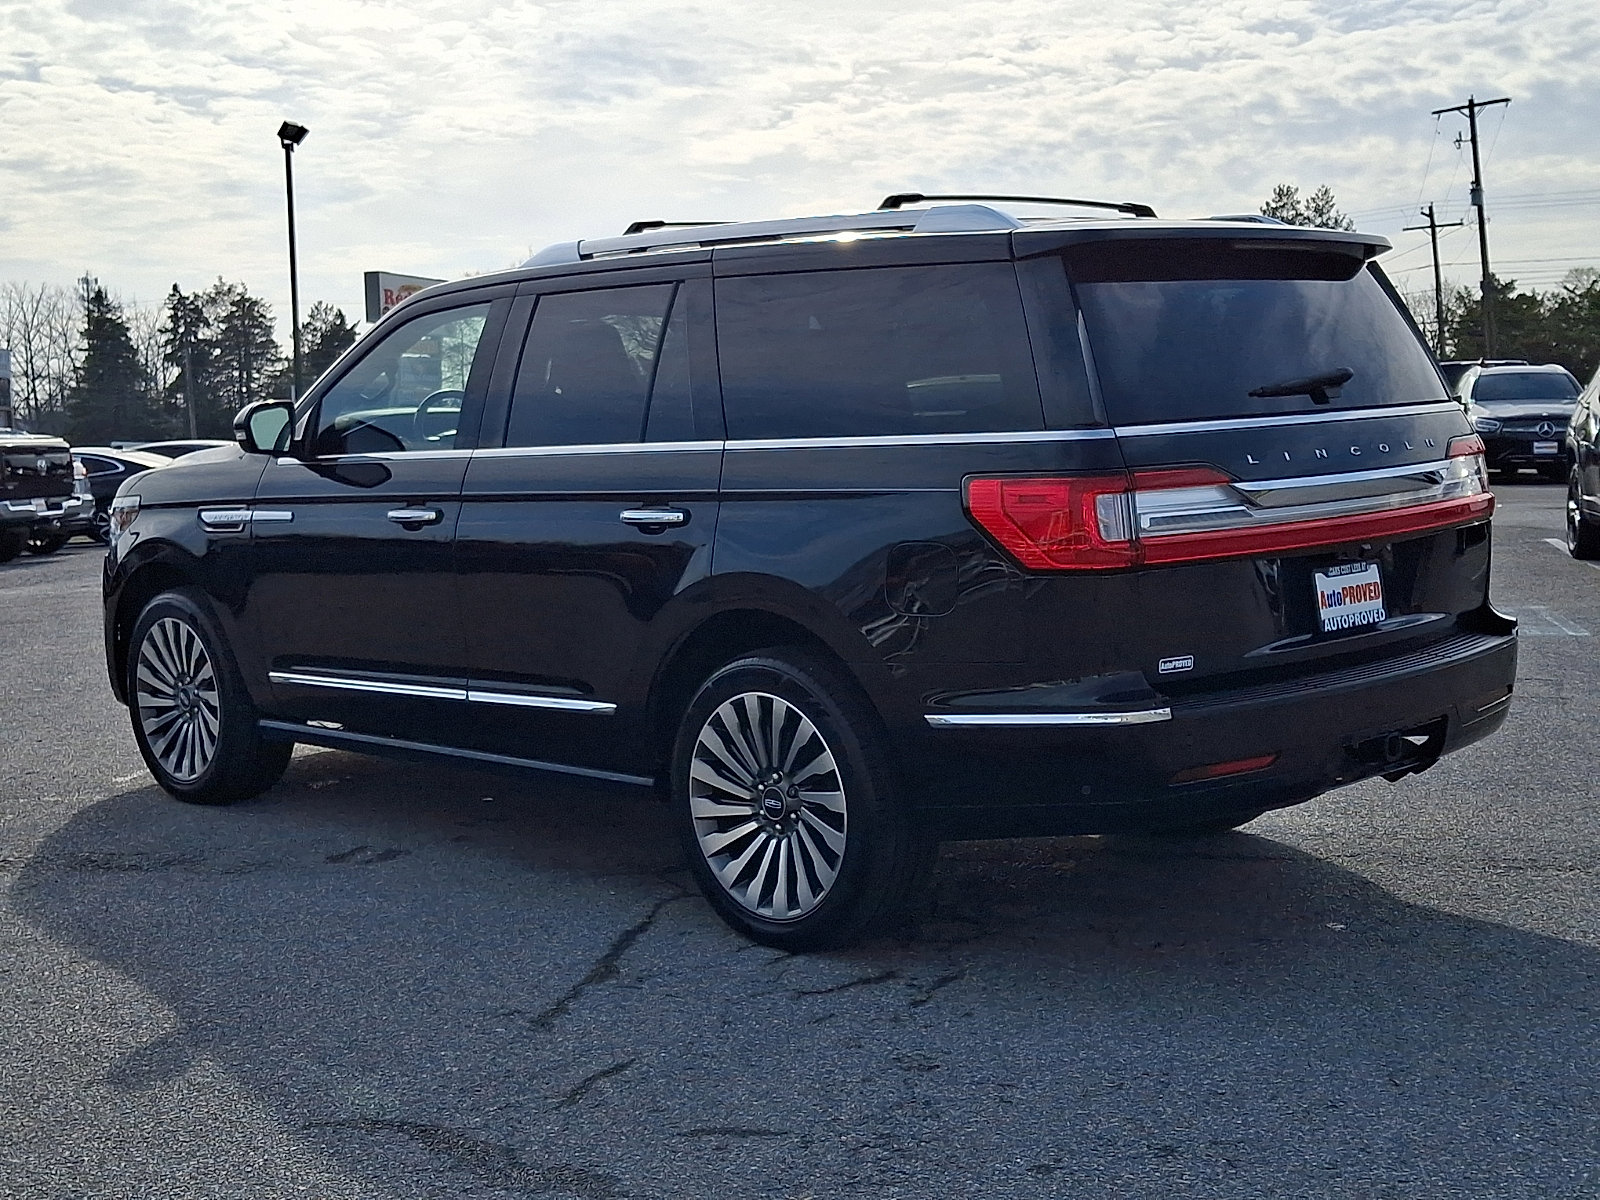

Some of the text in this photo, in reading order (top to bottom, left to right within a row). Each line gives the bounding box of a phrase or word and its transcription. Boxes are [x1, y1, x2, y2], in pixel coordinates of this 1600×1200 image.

[1247, 438, 1434, 464] LINCOLN
[1320, 581, 1381, 610] AutoPROVED
[1324, 608, 1386, 632] AUTOPROVED
